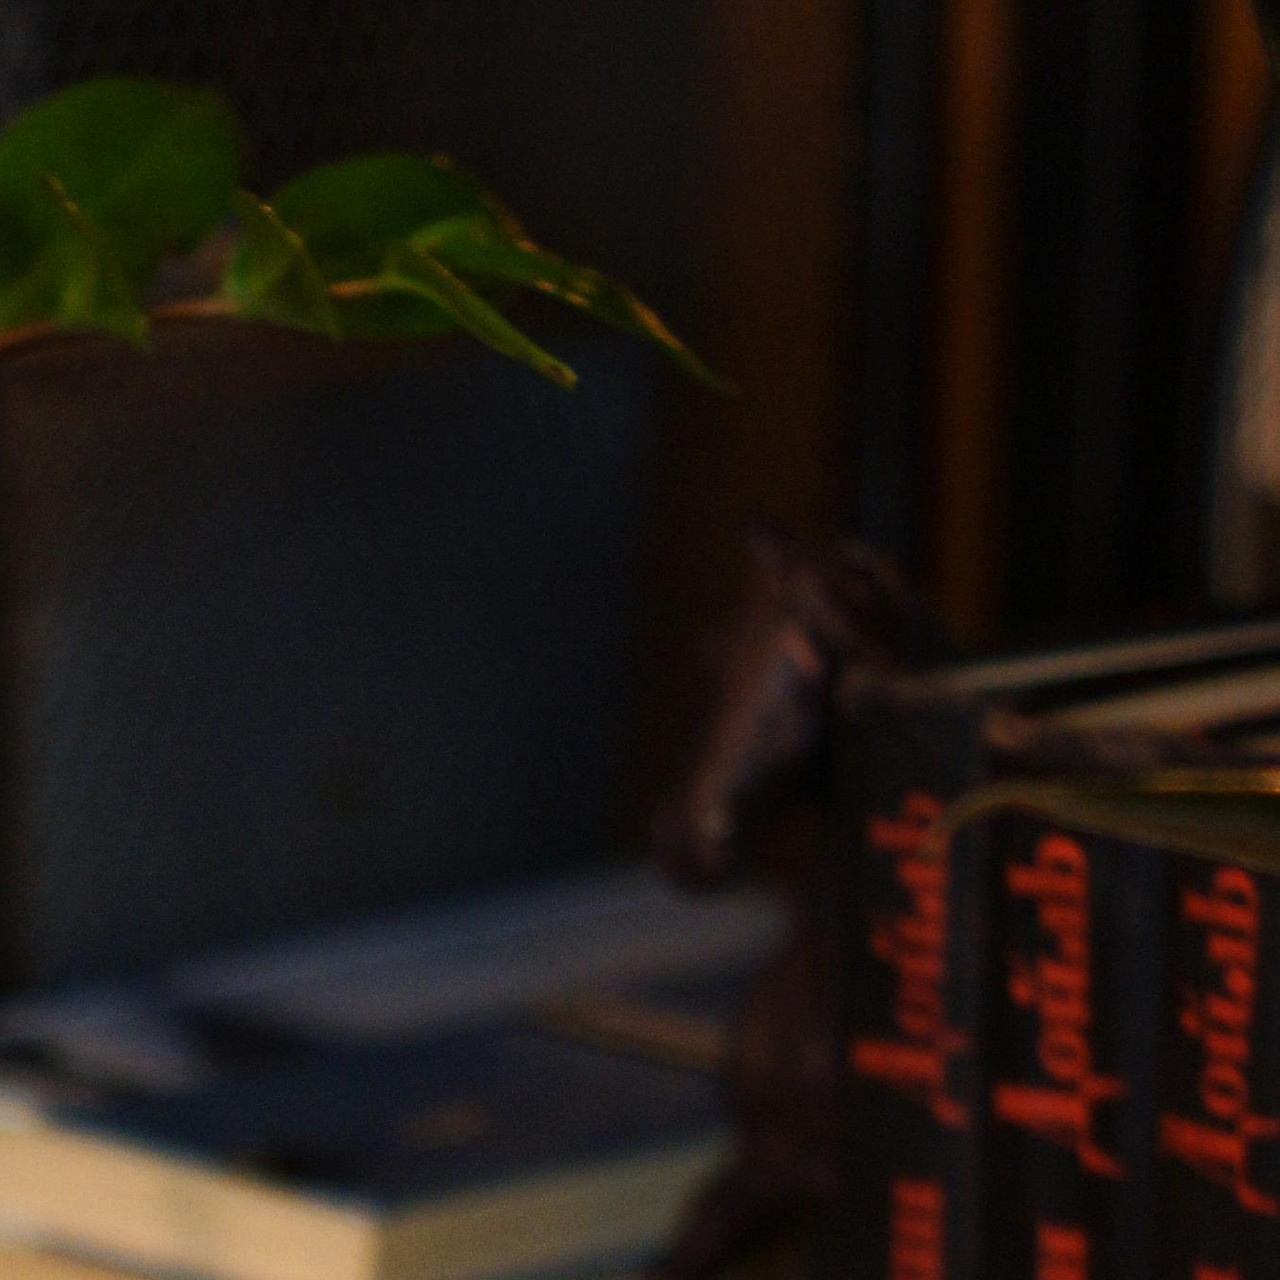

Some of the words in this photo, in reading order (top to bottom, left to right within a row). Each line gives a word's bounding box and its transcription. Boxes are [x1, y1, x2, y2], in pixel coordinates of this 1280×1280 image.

[850, 795, 968, 1126] Дойль
[994, 834, 1126, 1178] Дойль
[1158, 866, 1280, 1216] Дойль
